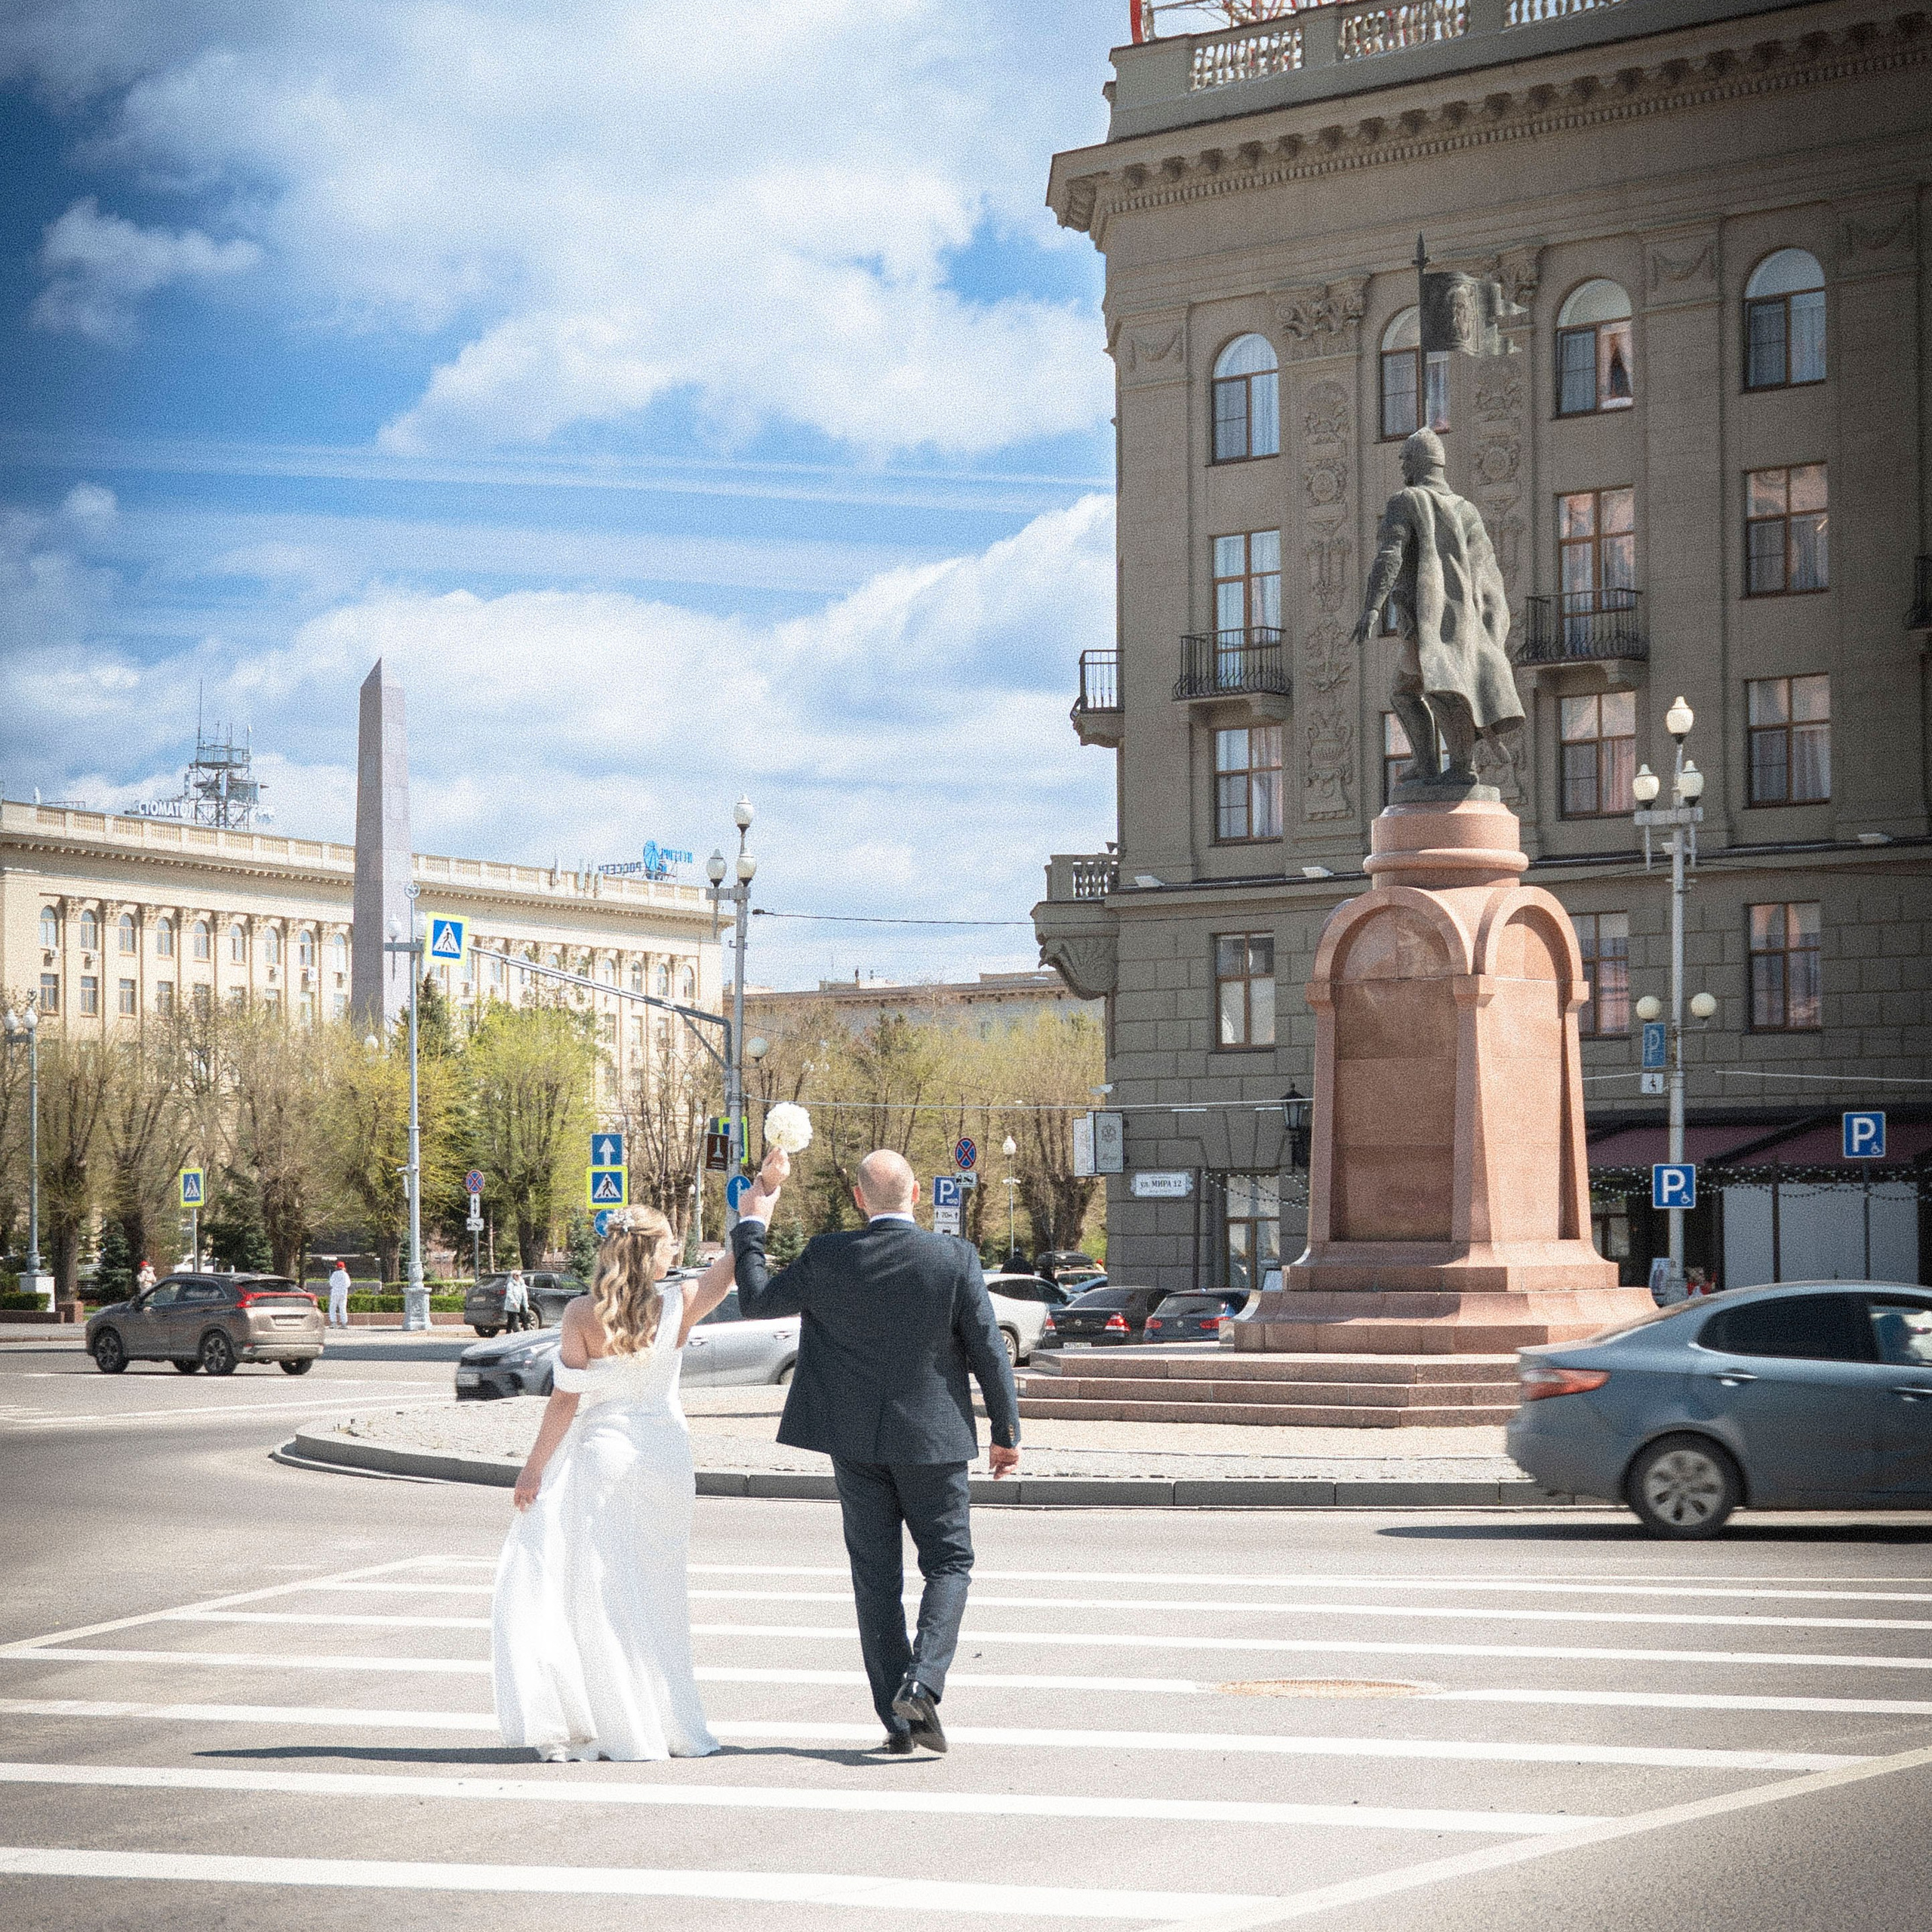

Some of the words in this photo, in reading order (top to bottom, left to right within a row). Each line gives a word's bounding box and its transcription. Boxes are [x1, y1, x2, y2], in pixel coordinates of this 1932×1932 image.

[1852, 1118, 1876, 1152] P
[940, 1180, 955, 1203] P
[1663, 1169, 1686, 1203] P
